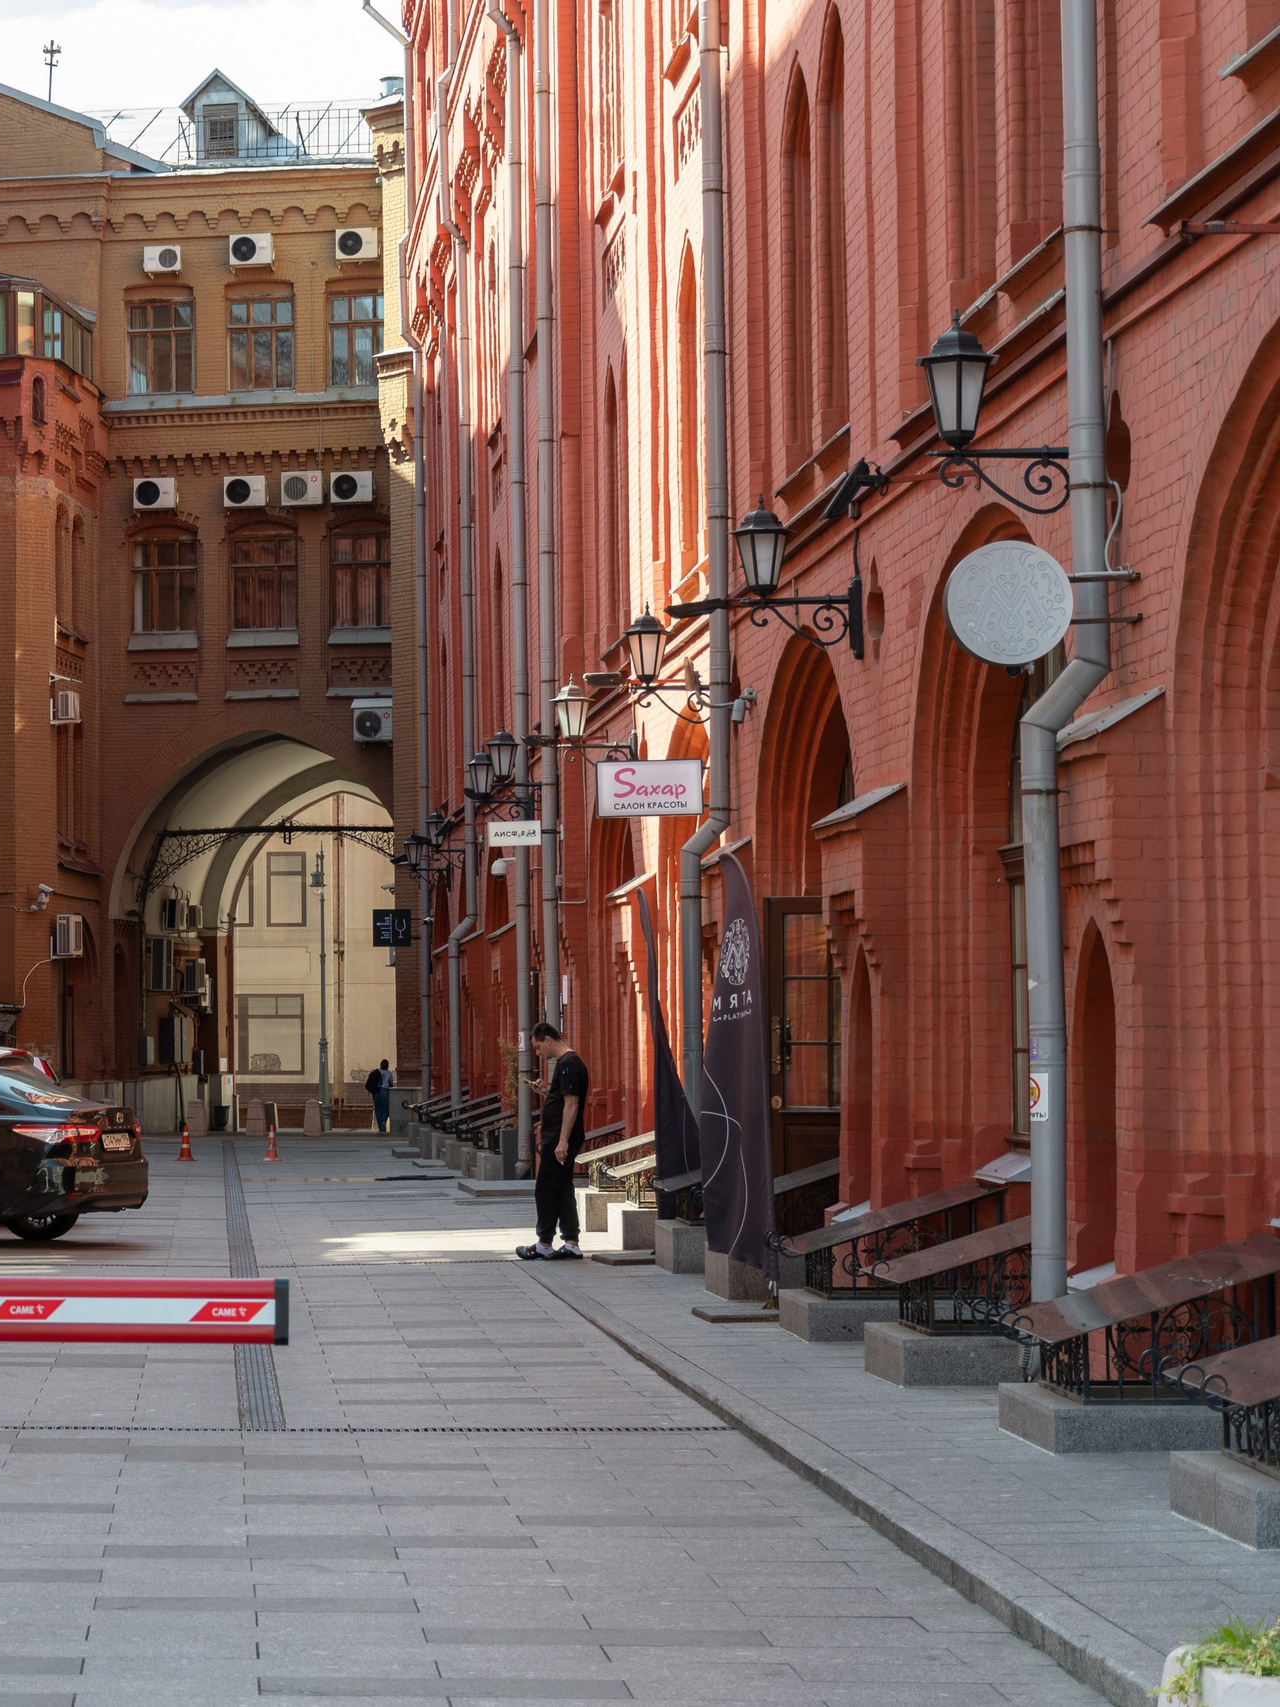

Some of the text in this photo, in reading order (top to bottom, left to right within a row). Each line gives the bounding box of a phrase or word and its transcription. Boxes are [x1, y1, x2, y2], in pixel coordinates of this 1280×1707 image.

[613, 767, 687, 799] Sахар
[613, 801, 688, 810] САЛОН КРАСОТЫ
[10, 1305, 35, 1314] CAME
[211, 1307, 237, 1317] CAME
